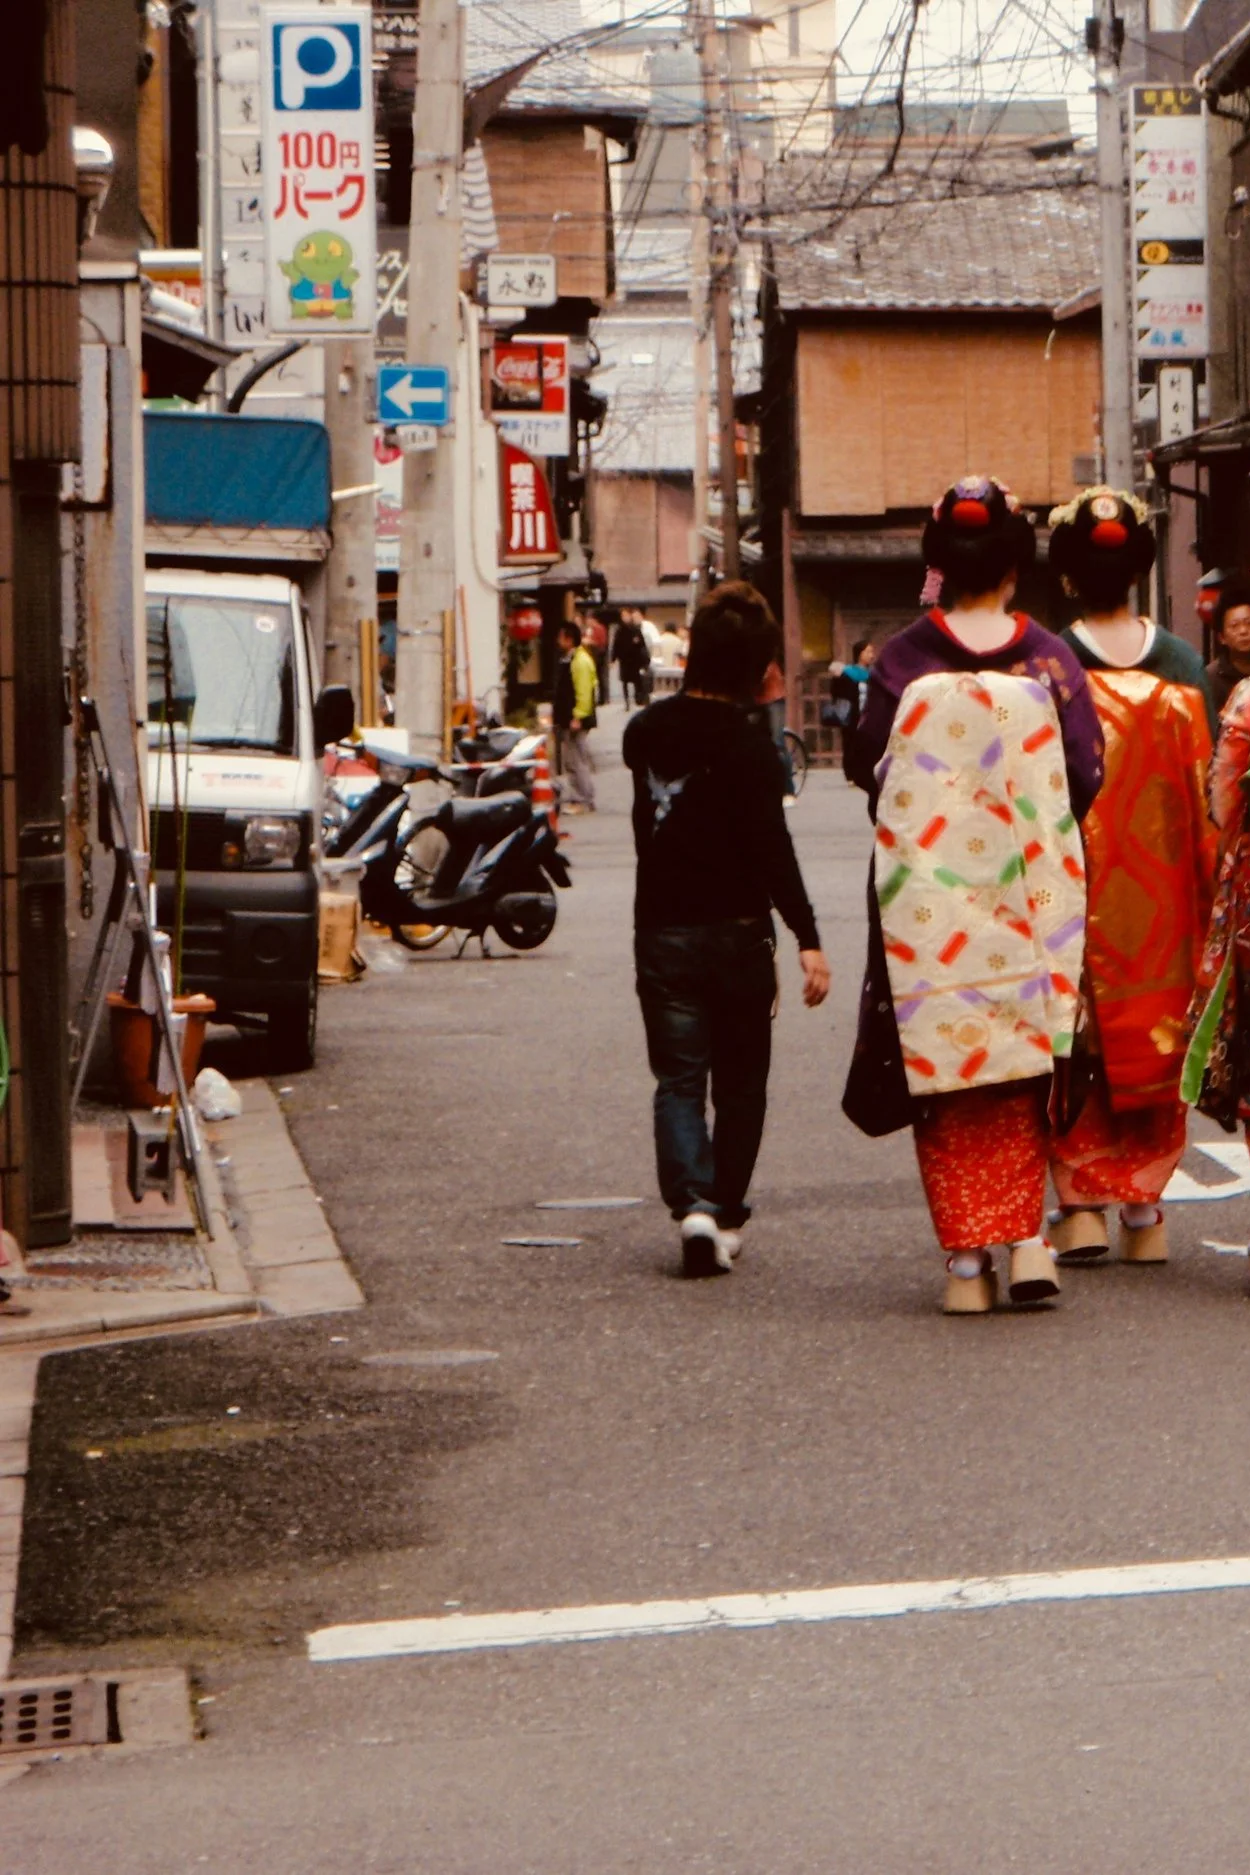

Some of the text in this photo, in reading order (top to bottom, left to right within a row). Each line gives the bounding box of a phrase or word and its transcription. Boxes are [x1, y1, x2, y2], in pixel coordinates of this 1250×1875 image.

[279, 25, 354, 110] P
[278, 131, 361, 170] 100円
[273, 173, 365, 220] パーク
